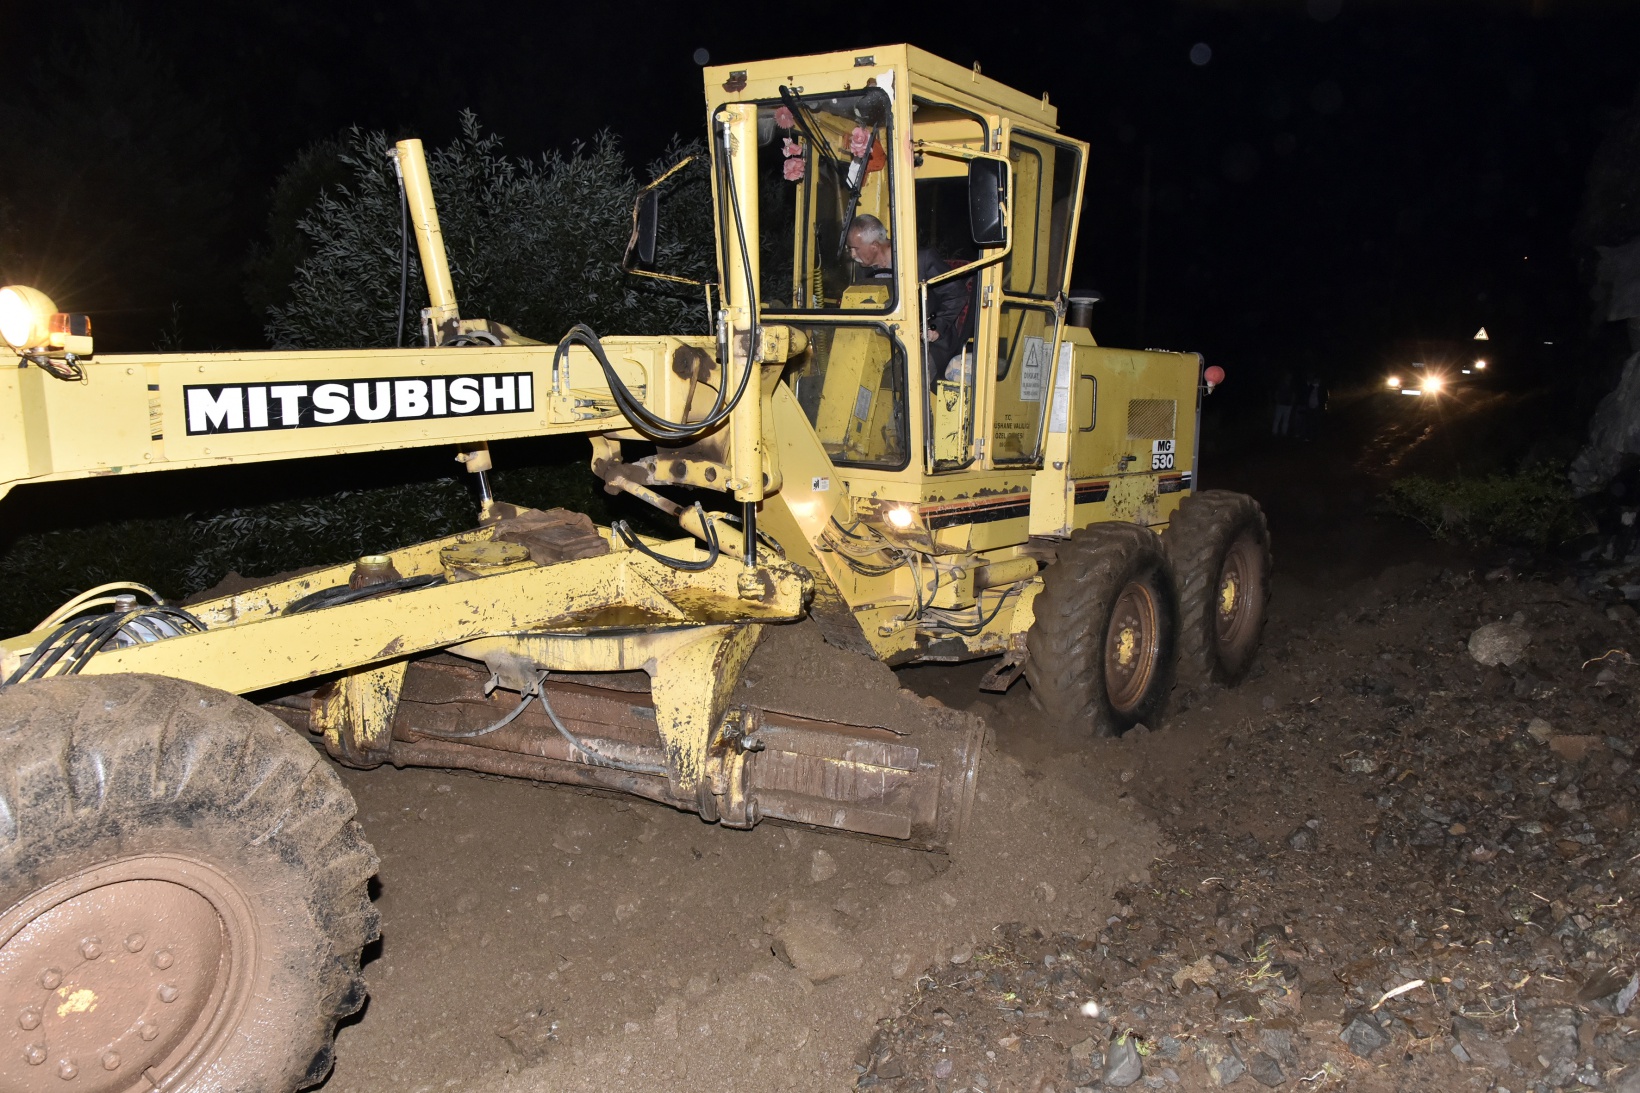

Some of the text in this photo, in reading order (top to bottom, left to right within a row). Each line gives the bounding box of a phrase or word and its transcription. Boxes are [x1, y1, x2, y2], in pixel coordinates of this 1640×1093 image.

[187, 375, 533, 433] MITSUBISHI
[1157, 440, 1171, 452] MG
[1152, 453, 1174, 470] 530
